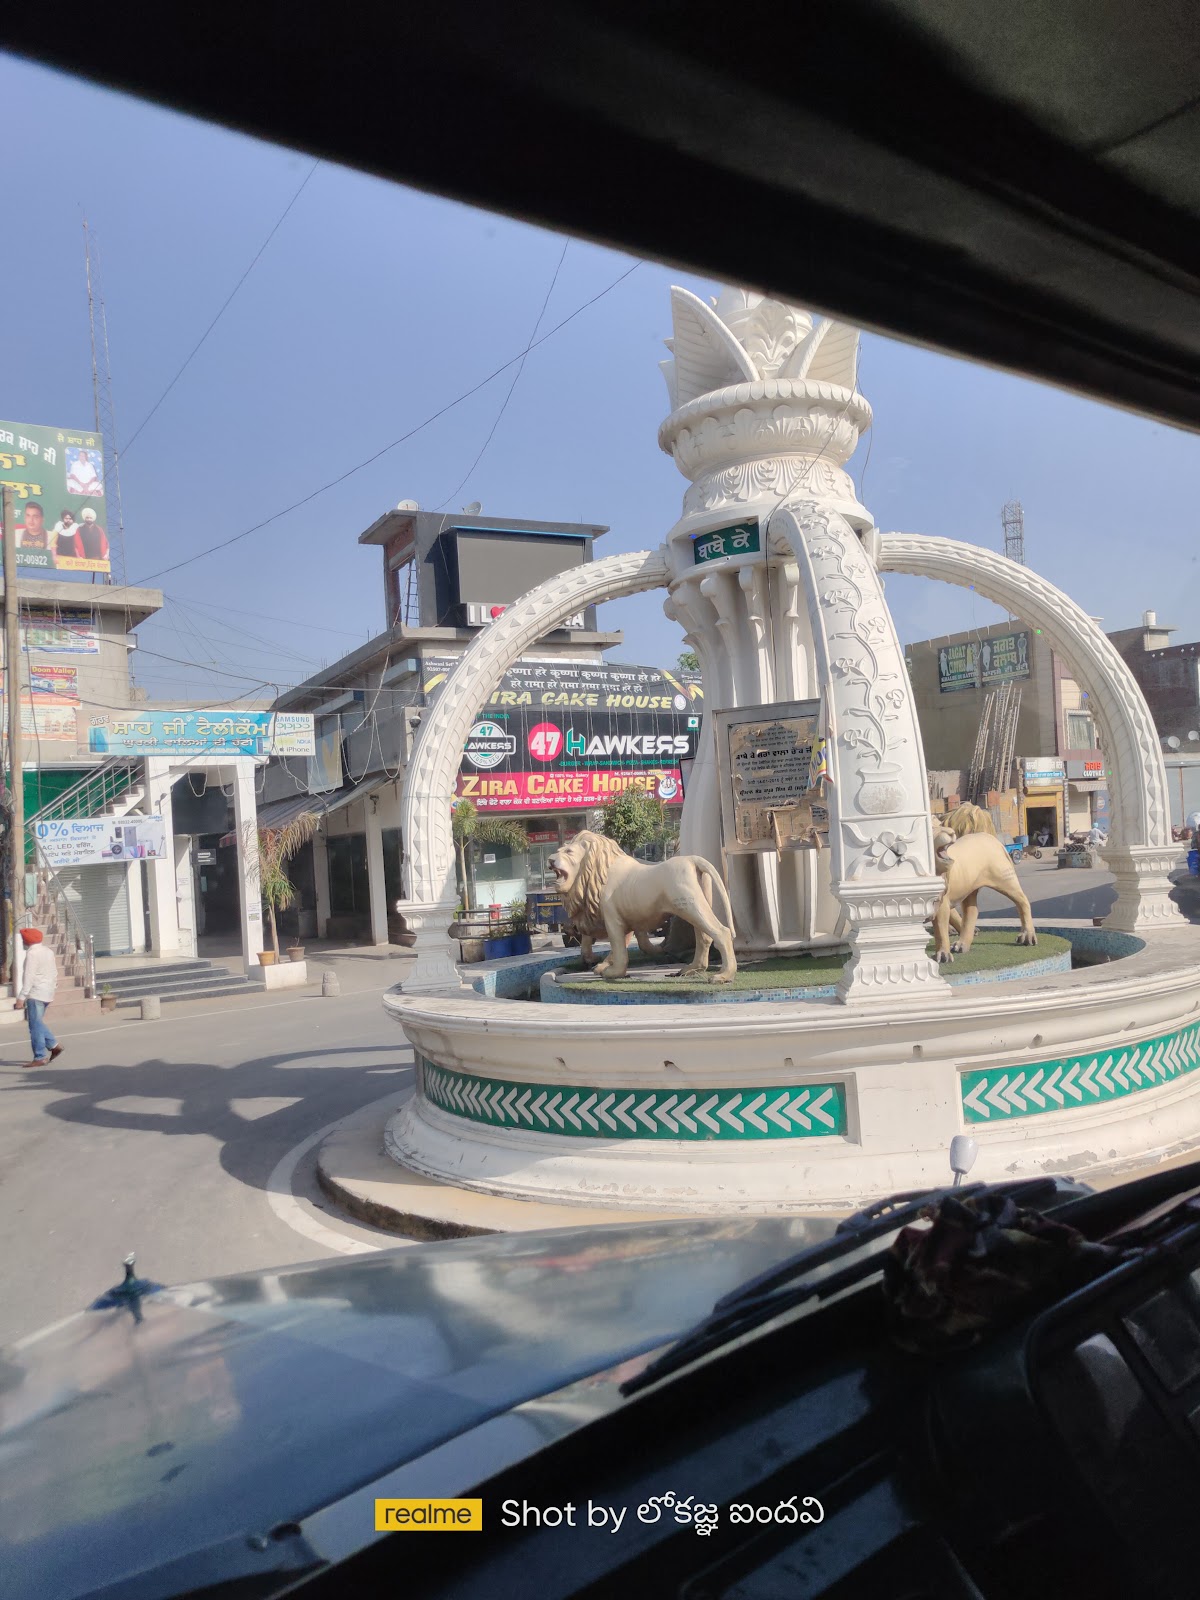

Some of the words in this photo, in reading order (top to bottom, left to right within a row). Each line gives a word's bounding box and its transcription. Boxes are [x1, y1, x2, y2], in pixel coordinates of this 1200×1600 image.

[698, 535, 727, 559] ਬਾਬੇ
[731, 529, 750, 548] ਕੇ
[53, 667, 76, 675] Valley
[535, 666, 547, 677] हरे
[510, 678, 521, 688] हरे
[547, 679, 558, 689] हरे
[490, 691, 532, 705] IRA
[541, 692, 599, 706] CAKE
[606, 694, 672, 709] HOUSE
[112, 721, 153, 735] ਸ਼ਾਹ
[162, 717, 187, 735] ਜੀ
[480, 726, 493, 736] 47
[531, 731, 560, 756] 47
[566, 727, 690, 757] HAWKERS
[461, 775, 518, 796] ZIRA
[527, 774, 583, 795] CAKE
[593, 773, 655, 792] HOUSE
[38, 822, 69, 837] 0%
[72, 823, 105, 834] ਵਿਆਜ
